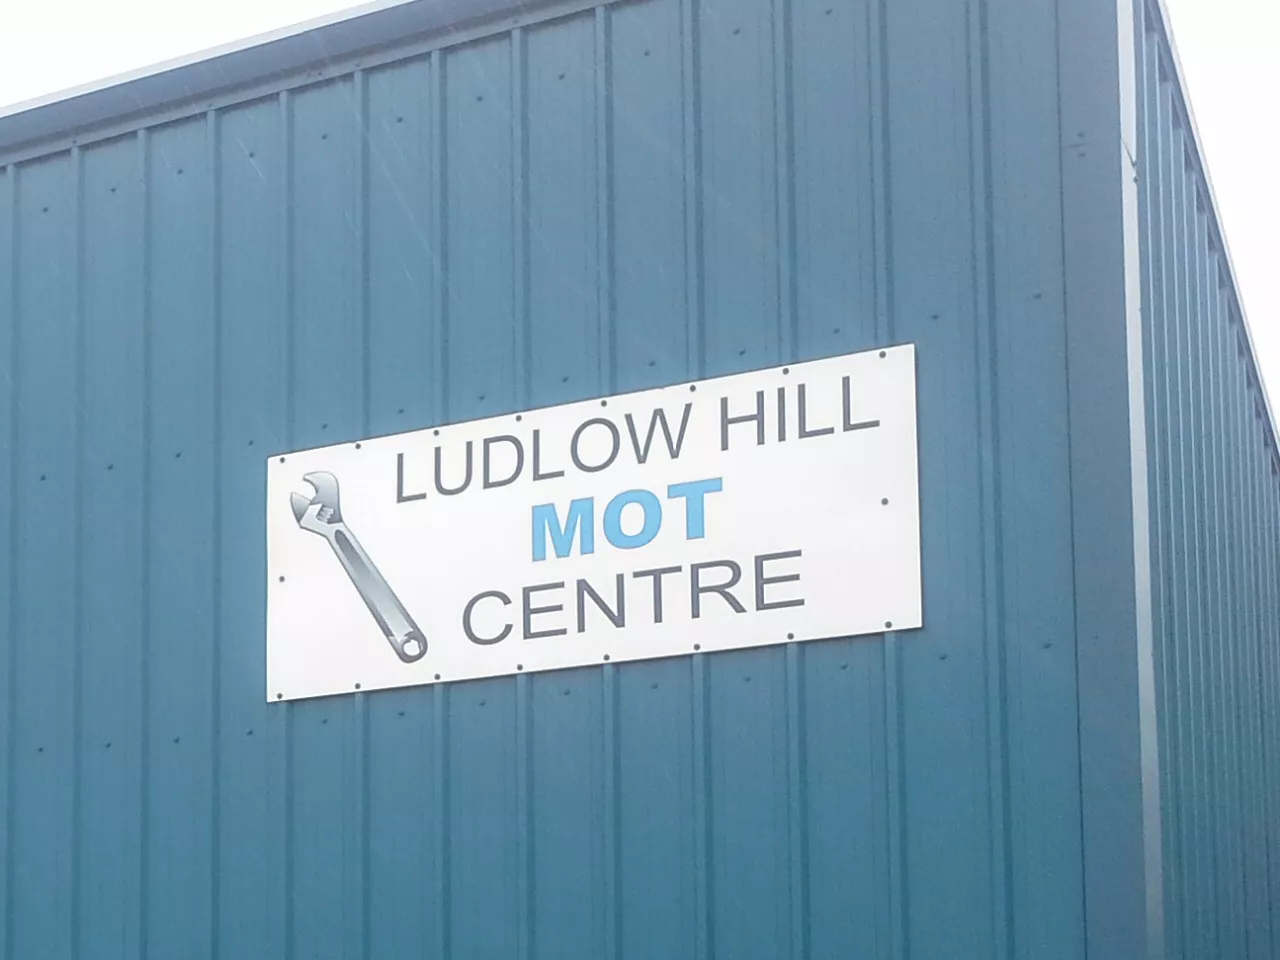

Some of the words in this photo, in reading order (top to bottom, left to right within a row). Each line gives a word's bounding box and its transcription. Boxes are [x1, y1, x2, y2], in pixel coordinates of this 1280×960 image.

[396, 403, 692, 504] LUDLOW
[720, 375, 880, 451] HILL
[531, 477, 723, 562] MOT
[462, 549, 804, 646] CENTRE
